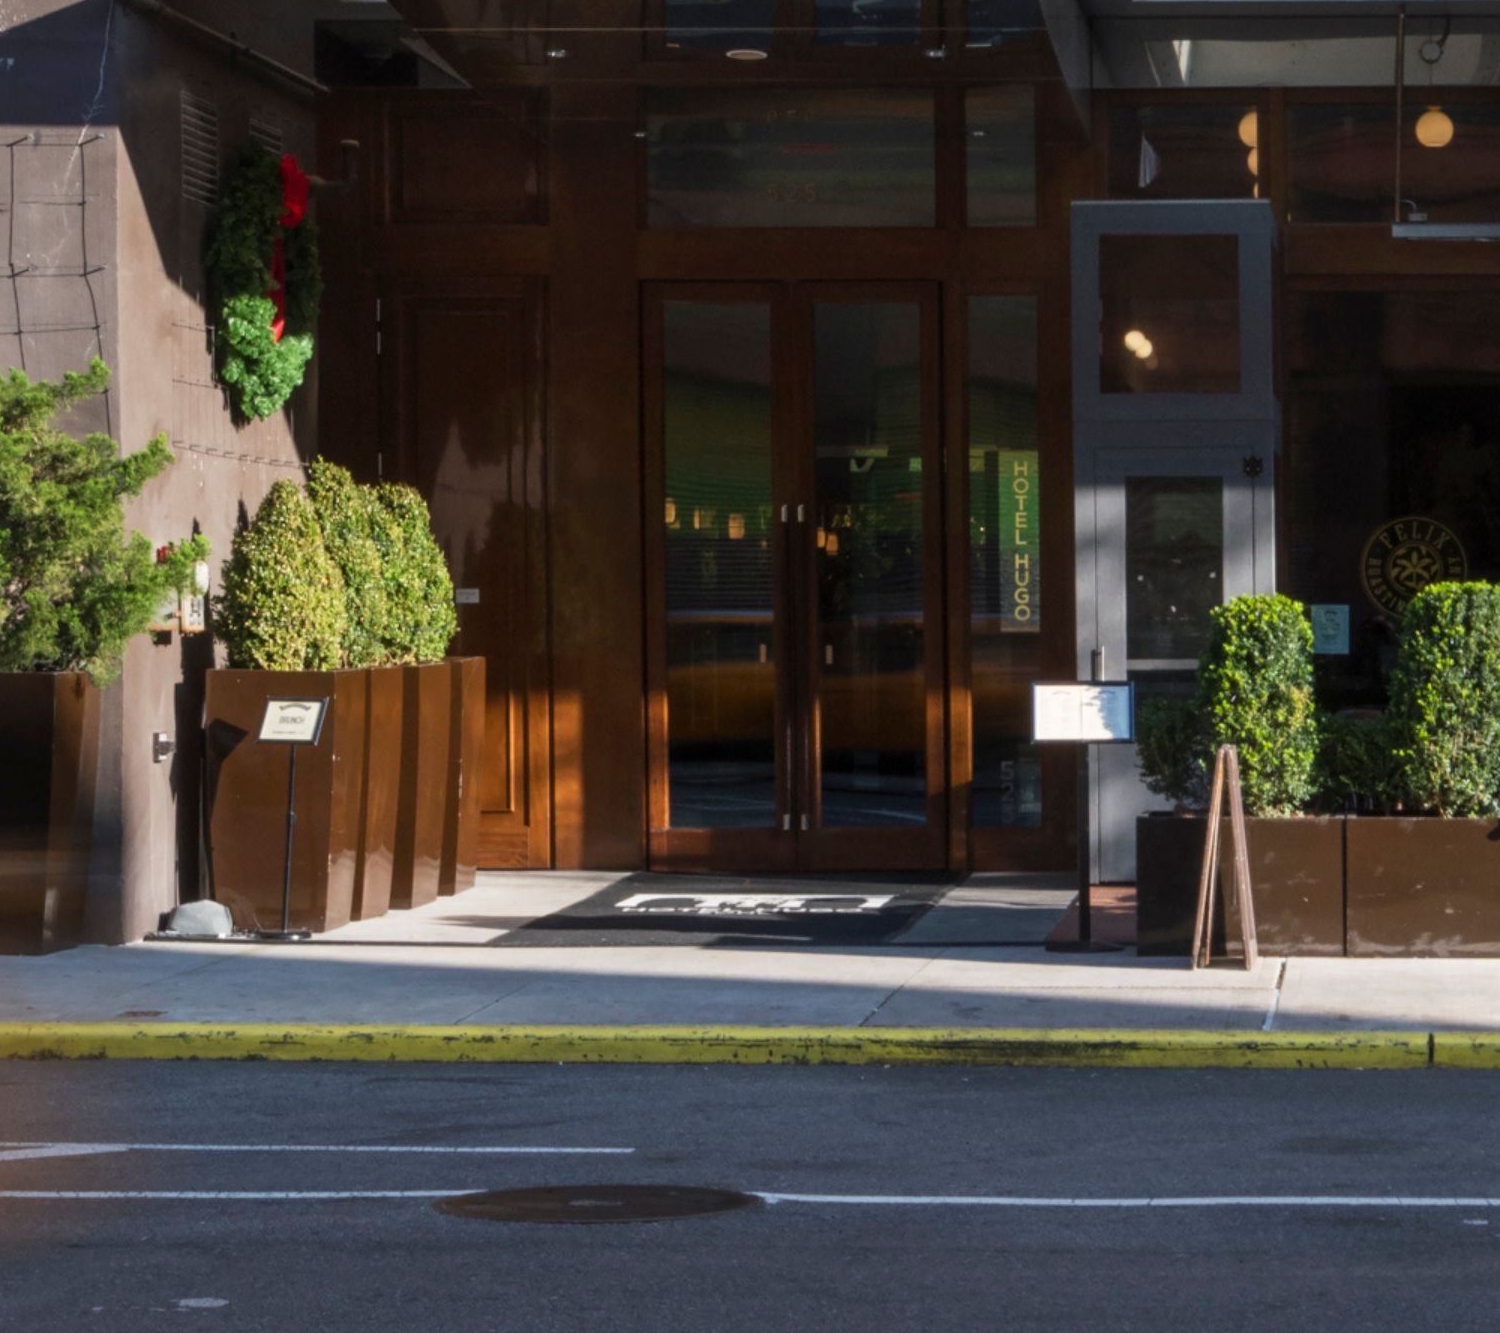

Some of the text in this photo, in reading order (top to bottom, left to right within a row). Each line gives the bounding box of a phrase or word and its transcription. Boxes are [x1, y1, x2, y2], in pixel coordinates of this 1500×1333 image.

[1012, 460, 1031, 622] HOTEL HUGO
[1377, 520, 1451, 550] FELIX
